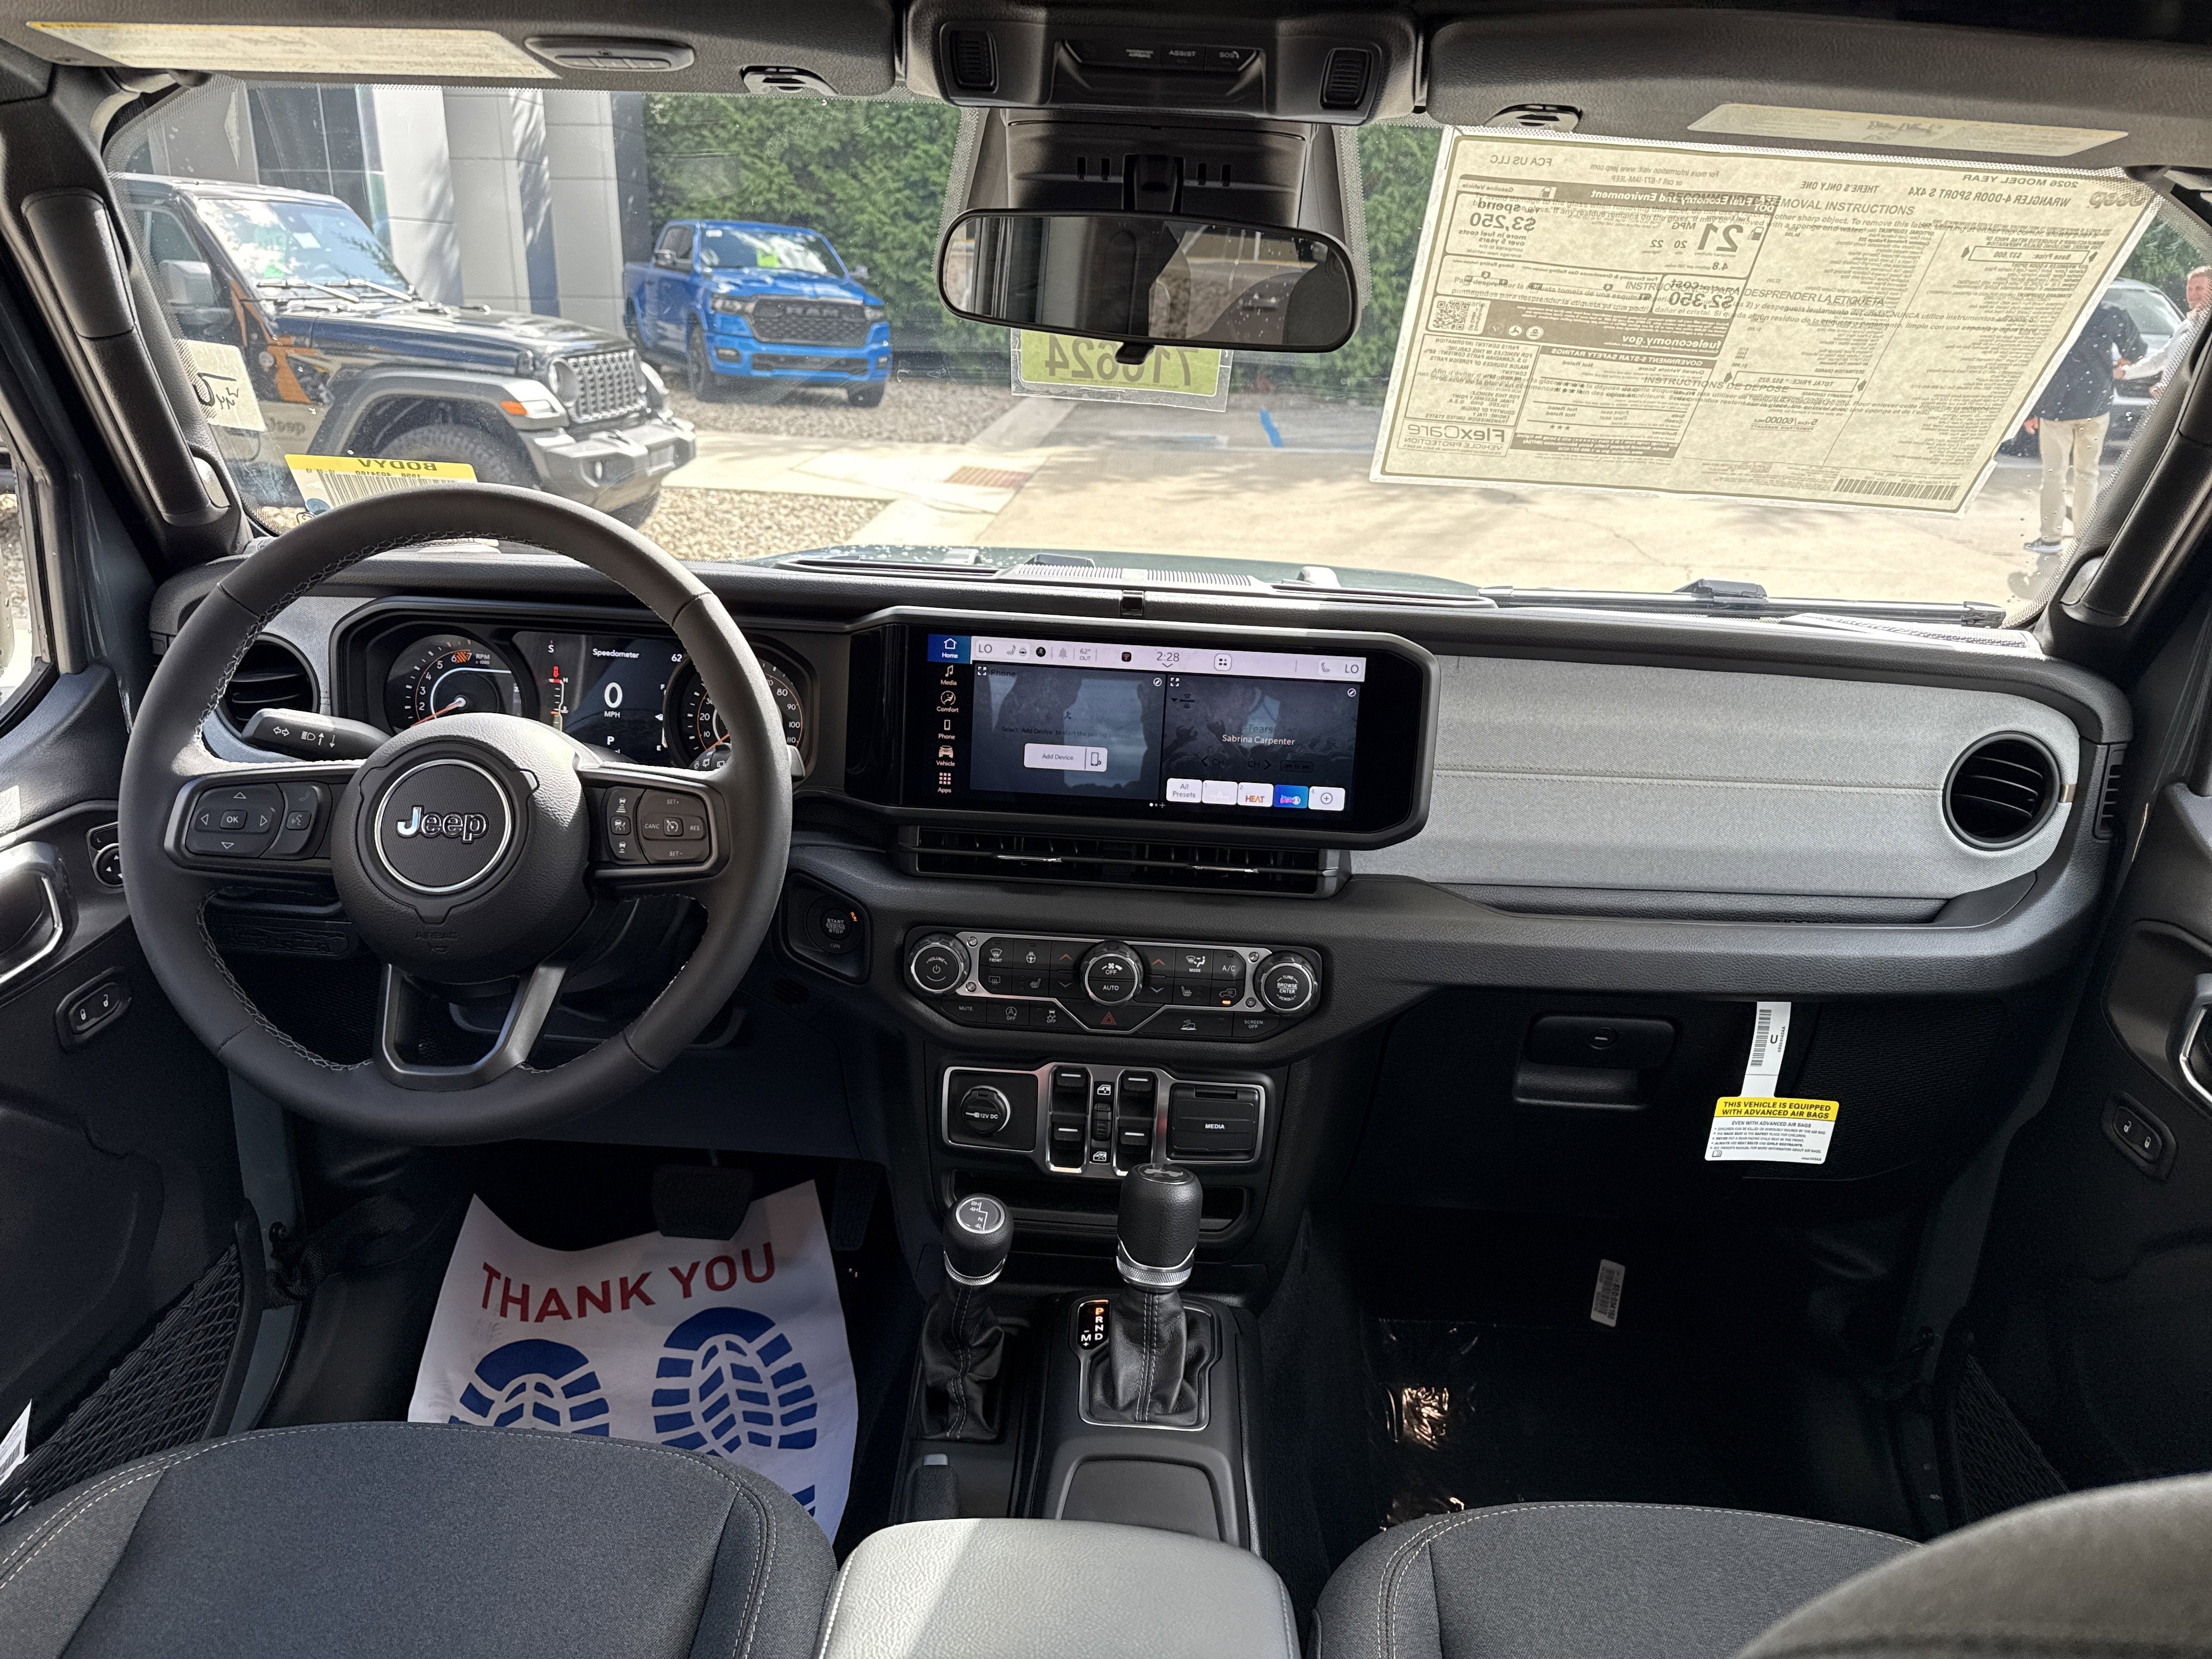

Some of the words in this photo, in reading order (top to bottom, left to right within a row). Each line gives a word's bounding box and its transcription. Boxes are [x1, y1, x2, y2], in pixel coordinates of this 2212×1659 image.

[1824, 202, 1915, 216] INSTRUCTIONS
[1745, 288, 1816, 303] DESPRENDER
[1818, 294, 1833, 303] LA
[786, 306, 839, 317] RAM
[549, 645, 554, 653] S
[592, 648, 640, 658] Speedometer
[979, 644, 992, 653] LO
[451, 654, 457, 662] 6
[466, 653, 472, 661] 7
[671, 654, 682, 662] 62
[1156, 652, 1180, 662] 2:28
[437, 661, 443, 669] 5
[1345, 664, 1358, 674] LO
[426, 672, 431, 680] 4
[991, 669, 1016, 677] Phone
[420, 687, 426, 695] 3
[604, 682, 623, 708] 0
[419, 702, 425, 710] 2
[1248, 724, 1273, 733] Tears
[607, 736, 614, 745] P
[1222, 734, 1252, 743] Sabrina
[1254, 736, 1295, 746] Carpenter
[1245, 795, 1265, 803] HEAT
[397, 806, 487, 843] Jeep
[1789, 1103, 1831, 1111] EQUIPPED
[482, 1262, 656, 1323] THANK
[668, 1242, 776, 1299] YOU
[1095, 1324, 1104, 1332] N
